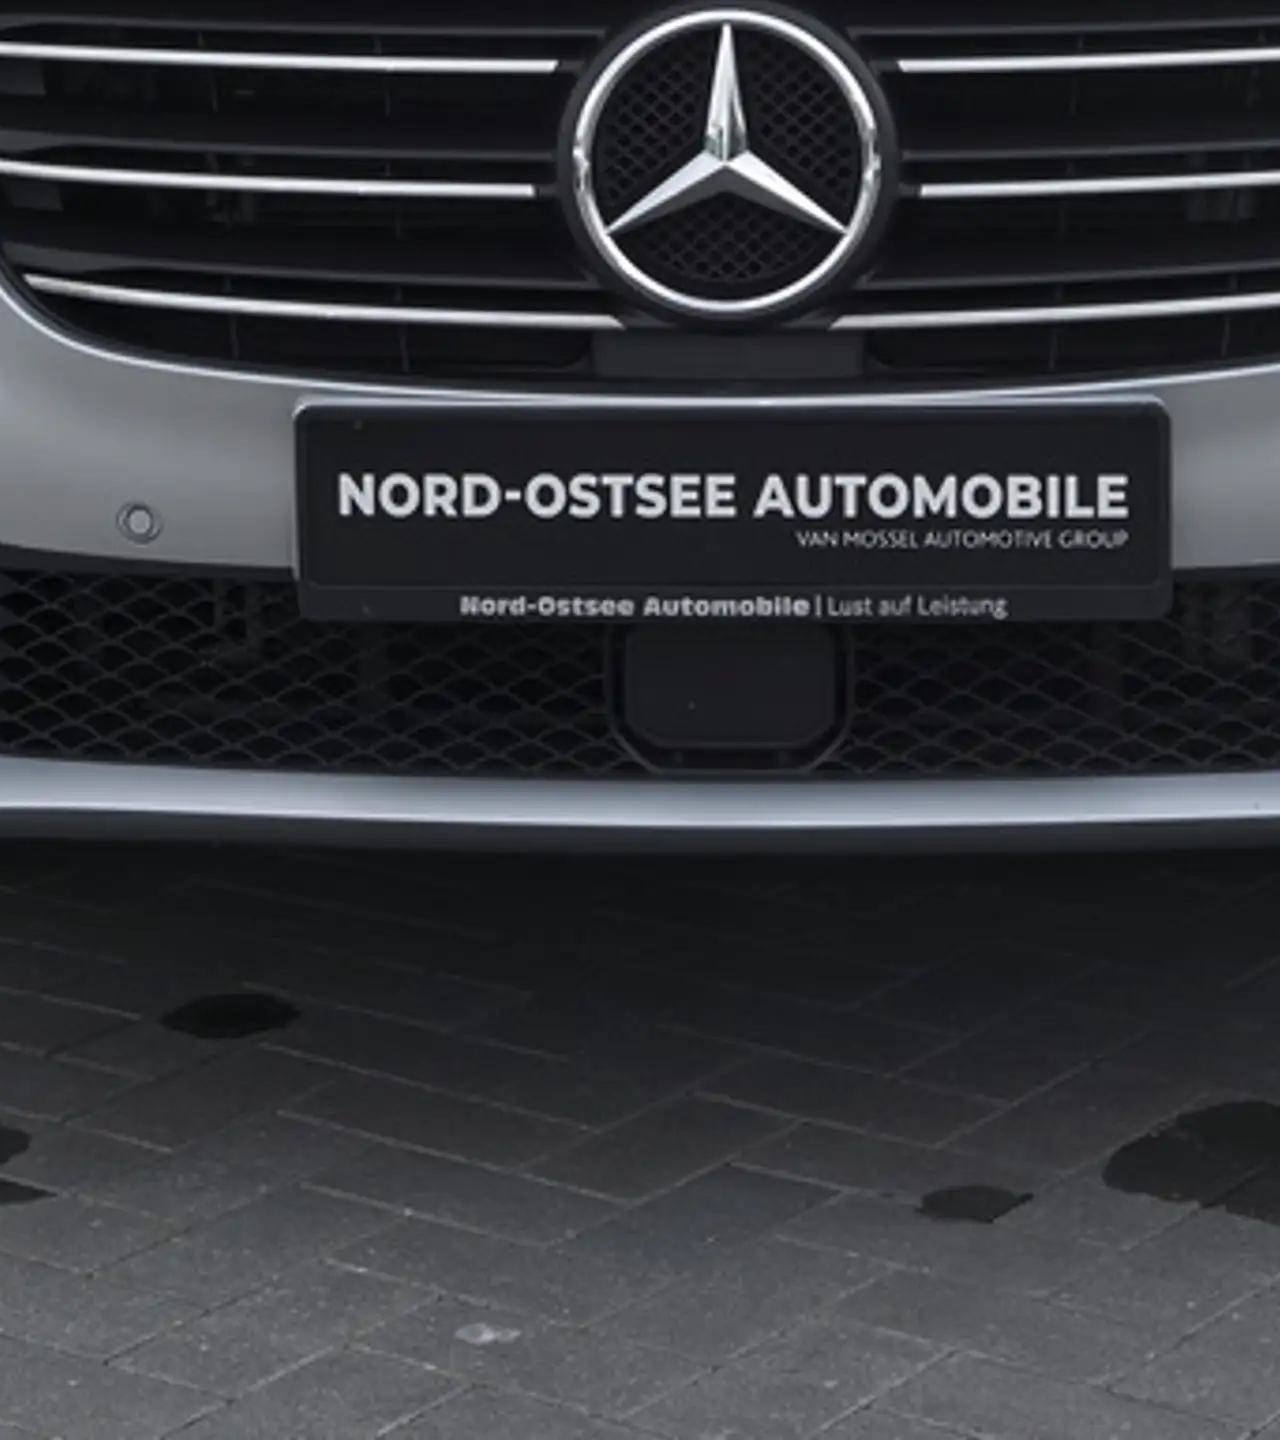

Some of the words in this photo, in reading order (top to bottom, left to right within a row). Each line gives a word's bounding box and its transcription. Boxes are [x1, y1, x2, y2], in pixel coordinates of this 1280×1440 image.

[340, 473, 737, 518] NORD-OSTSEE
[753, 473, 1129, 519] AUTOMOBILE
[795, 530, 838, 549] VAN
[842, 530, 918, 549] MOSSEL
[923, 529, 1052, 549] AUTOMOTIVE
[1057, 529, 1129, 549] GROUP
[459, 595, 635, 617] Nord-Ostsee
[643, 595, 811, 617] Automobile
[827, 596, 873, 617] Lust
[879, 595, 912, 616] auf
[917, 595, 1008, 620] Leistung
